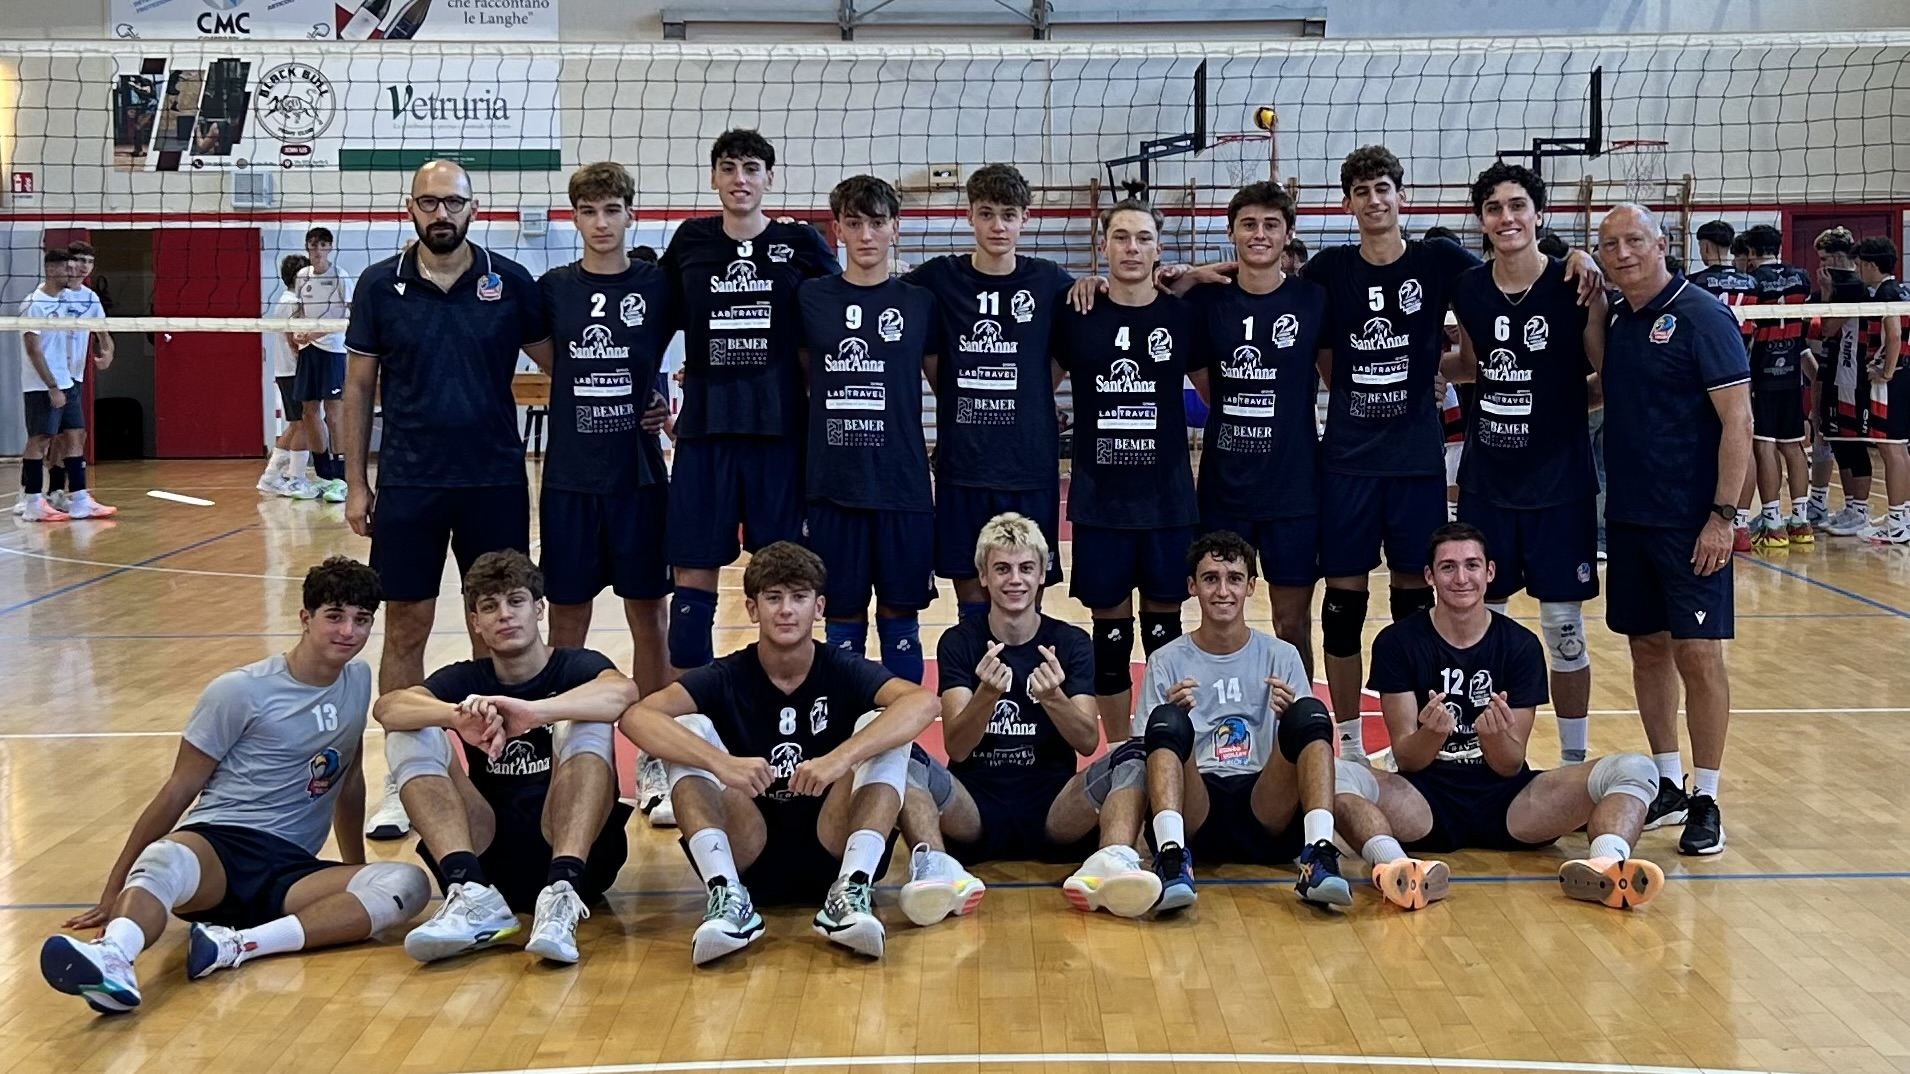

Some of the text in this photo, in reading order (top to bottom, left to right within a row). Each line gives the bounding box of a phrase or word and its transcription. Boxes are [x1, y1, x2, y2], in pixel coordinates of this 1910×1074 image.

[447, 0, 550, 9] che raccontano
[197, 12, 250, 34] CMC
[463, 11, 476, 24] le
[258, 67, 329, 98] BLACK BULL
[386, 84, 510, 120] Vetruria
[710, 276, 774, 293] Sant'Anna
[590, 293, 607, 317] 2
[976, 291, 999, 315] 11
[1368, 286, 1386, 311] 5
[845, 304, 862, 329] 9
[1242, 316, 1254, 341] 1
[1494, 315, 1510, 341] 6
[727, 338, 768, 350] BEMER
[959, 335, 1018, 353] Sant'Anna
[1115, 326, 1131, 350] 4
[1350, 333, 1410, 350] Sant'Anna
[569, 341, 630, 359] Sant'Anna
[825, 354, 885, 372] Sant'Anna
[1220, 360, 1277, 379] Sant'Anna
[1096, 375, 1156, 392] Sant'Anna
[974, 398, 1016, 410] BEMER
[1367, 390, 1408, 403] BEMER
[593, 404, 634, 417] BEMER
[844, 419, 885, 432] BEMER
[1233, 425, 1273, 437] BEMER
[1490, 421, 1529, 434] BEMER
[1114, 438, 1156, 450] BEMER
[1440, 667, 1464, 695] 12
[1213, 677, 1242, 704] 14
[311, 703, 338, 732] 13
[779, 707, 797, 735] 8
[985, 717, 1037, 735] nt'Anna
[486, 757, 550, 775] Sant'Anna
